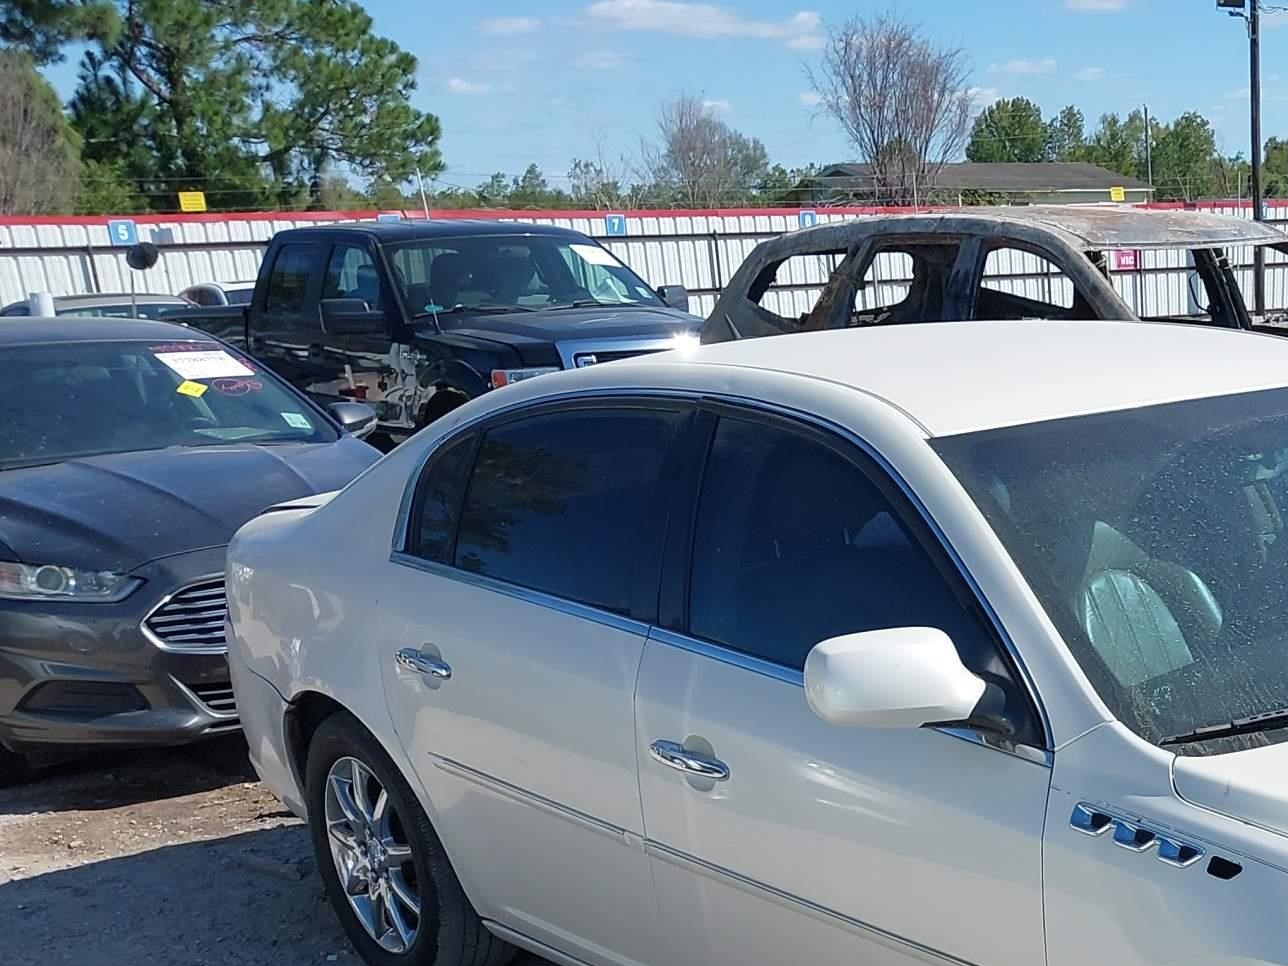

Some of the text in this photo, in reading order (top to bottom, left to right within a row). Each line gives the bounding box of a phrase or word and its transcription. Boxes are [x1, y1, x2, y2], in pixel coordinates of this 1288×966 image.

[611, 218, 621, 232] 7
[117, 224, 129, 241] 5
[1119, 255, 1136, 265] VIC
